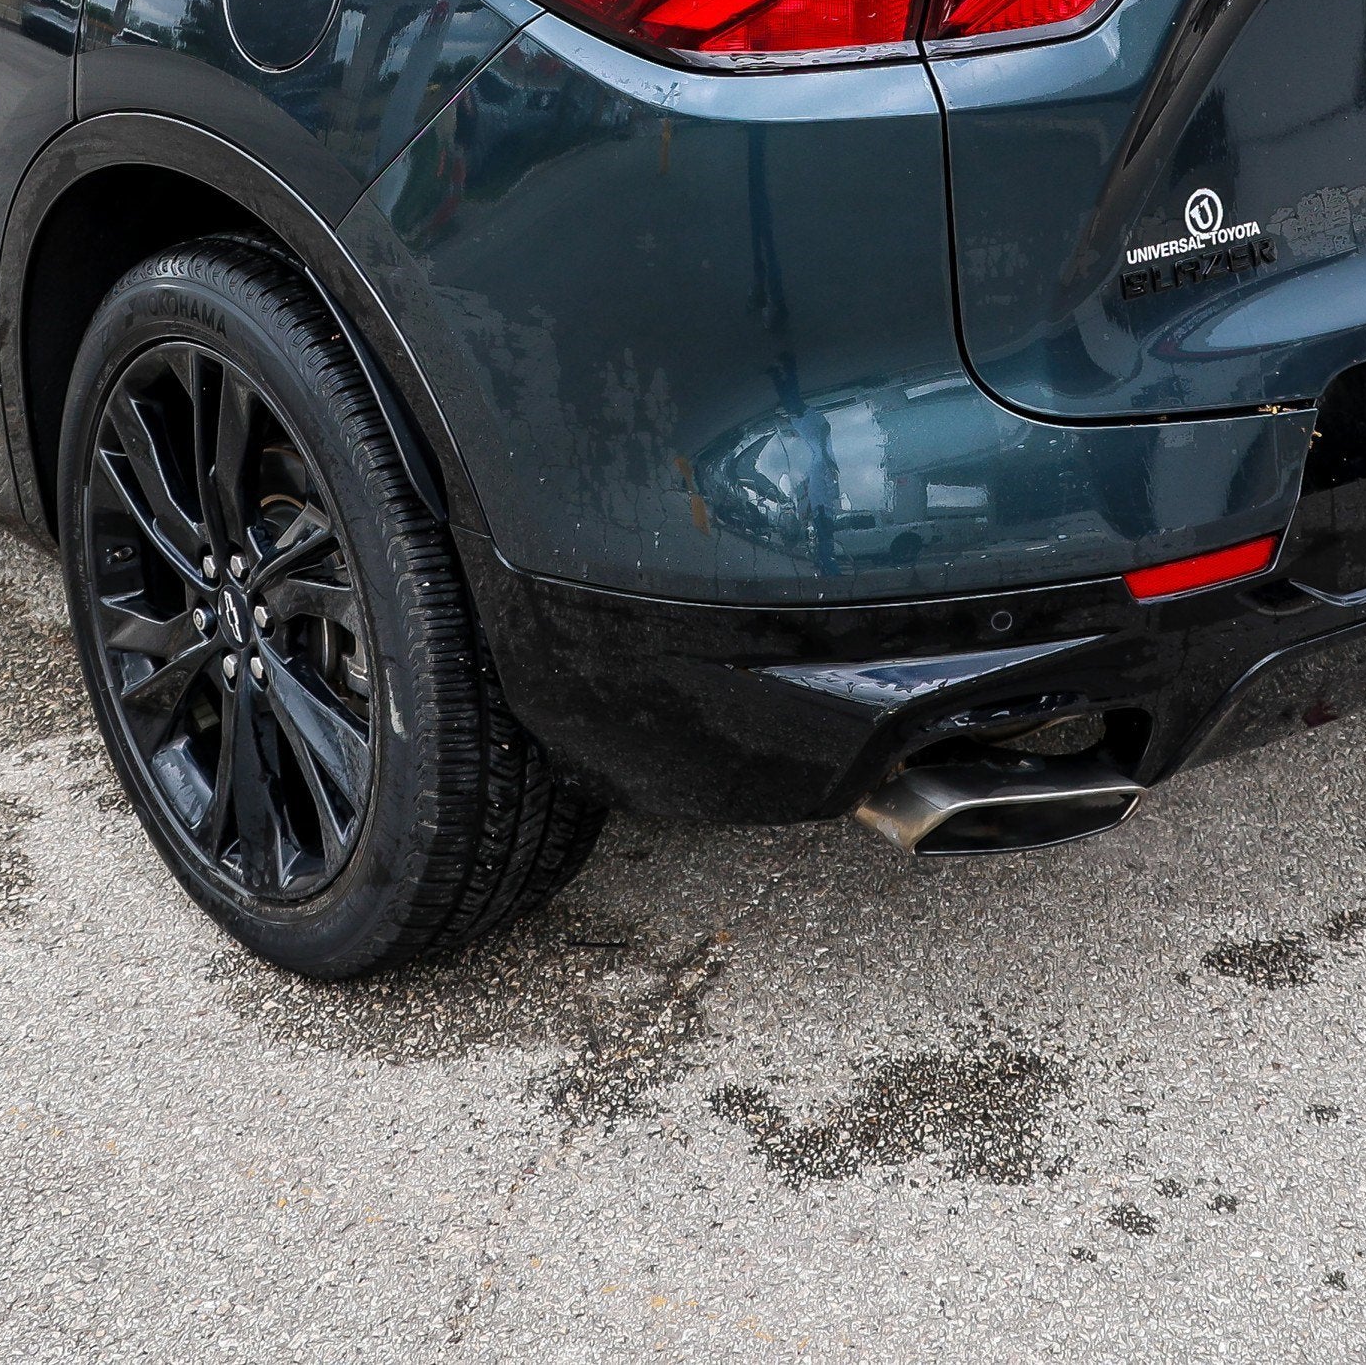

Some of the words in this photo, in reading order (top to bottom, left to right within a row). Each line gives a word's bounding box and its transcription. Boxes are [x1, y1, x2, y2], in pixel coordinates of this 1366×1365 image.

[1121, 237, 1278, 301] BLAZER
[1126, 235, 1206, 265] UNIVERSAL
[1208, 221, 1261, 247] TOYOTA
